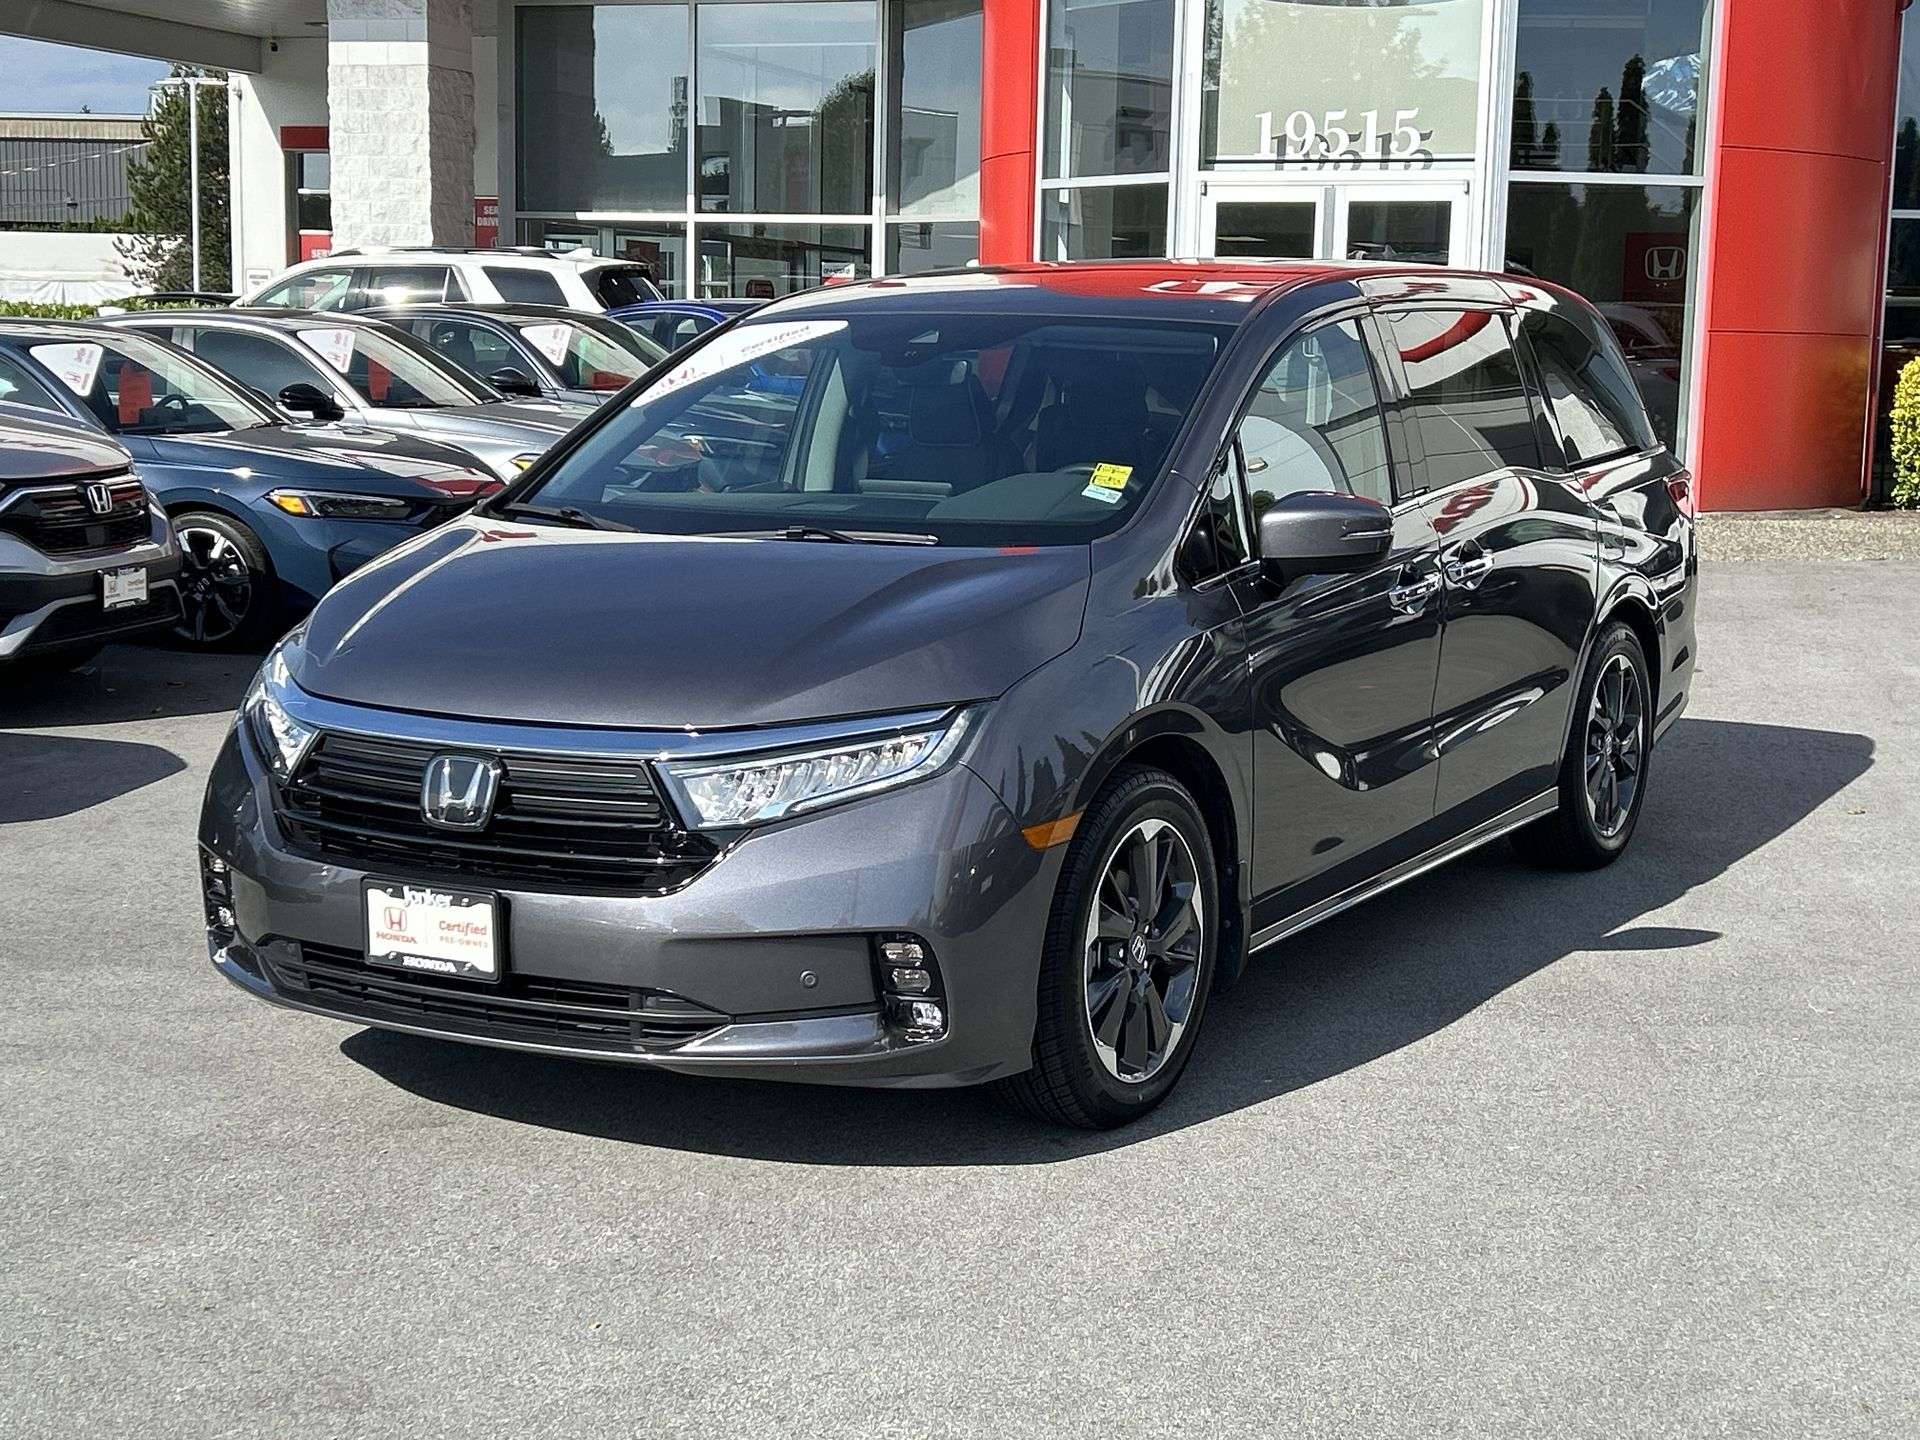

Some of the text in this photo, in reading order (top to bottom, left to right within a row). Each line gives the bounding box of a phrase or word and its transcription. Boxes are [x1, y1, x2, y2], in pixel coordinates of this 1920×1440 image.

[1254, 107, 1419, 156] 19515
[439, 920, 488, 936] Certified
[376, 931, 417, 944] HONDA
[402, 956, 458, 973] HONDA
